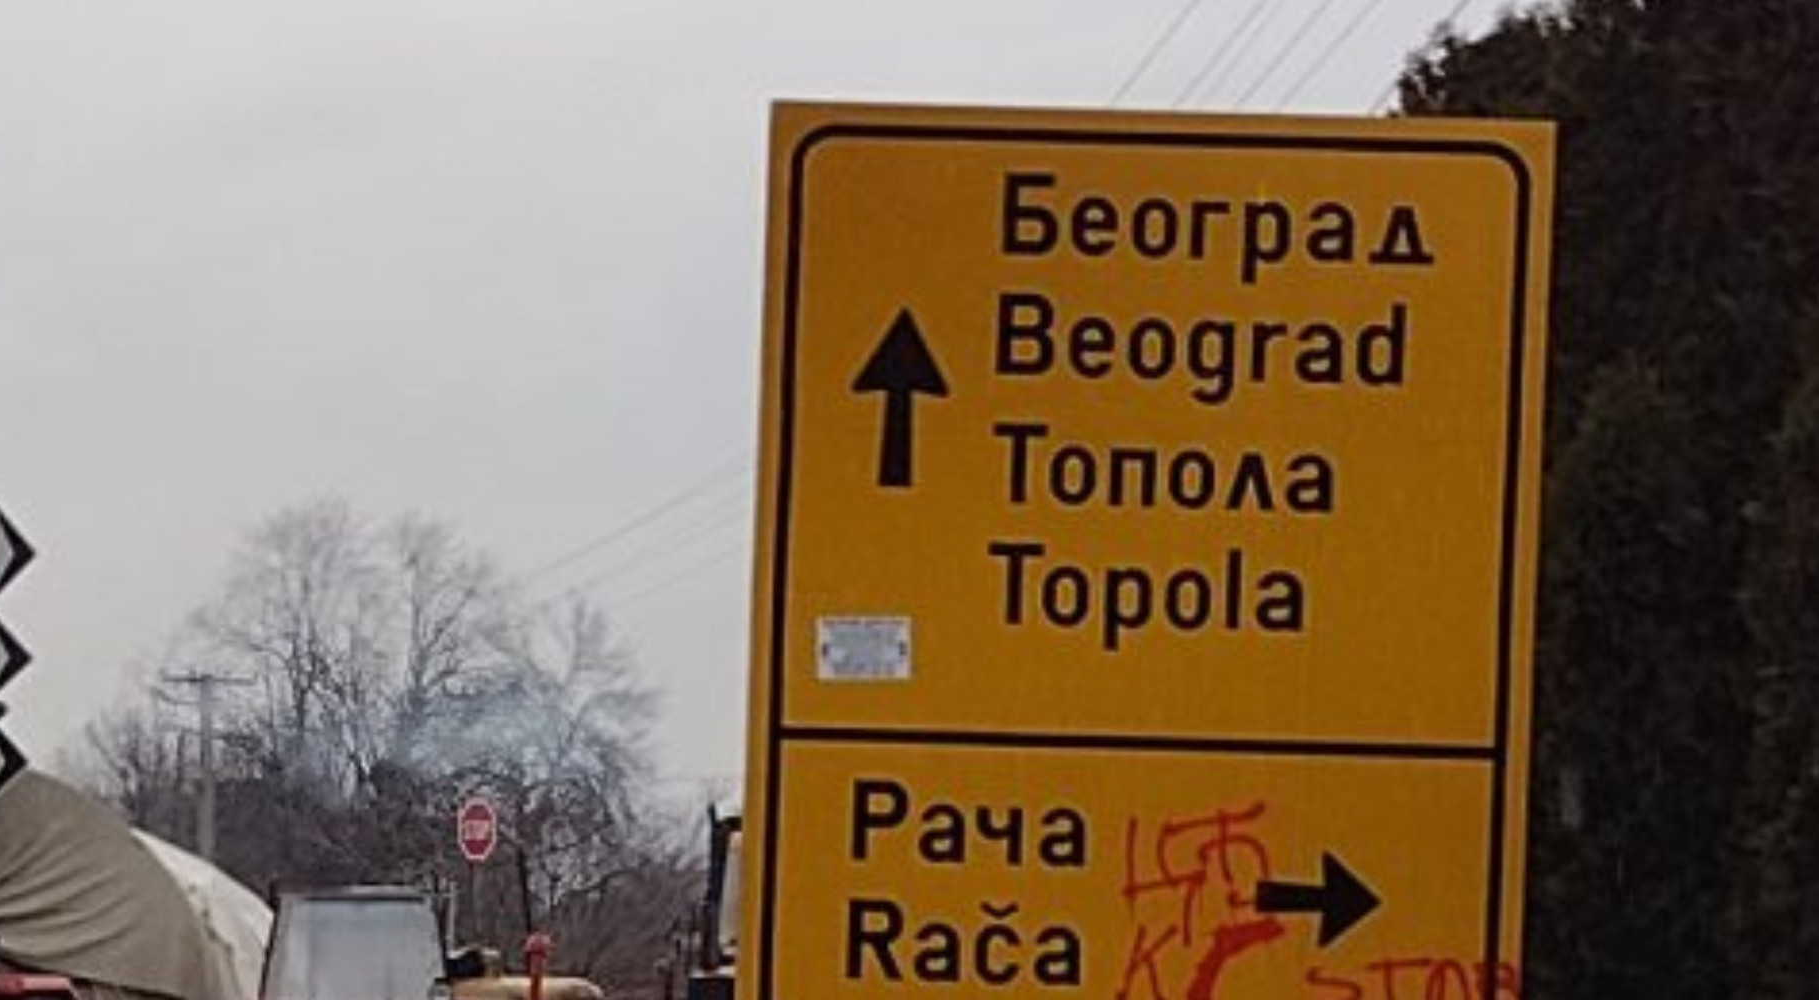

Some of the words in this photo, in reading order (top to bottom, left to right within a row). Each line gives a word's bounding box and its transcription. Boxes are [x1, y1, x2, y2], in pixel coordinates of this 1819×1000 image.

[1002, 173, 1435, 284] Београд
[995, 293, 1407, 405] Beograd
[992, 423, 1333, 513] Топола
[987, 542, 1305, 651] Topola
[851, 780, 1087, 867] Рача
[845, 898, 1082, 986] Rača
